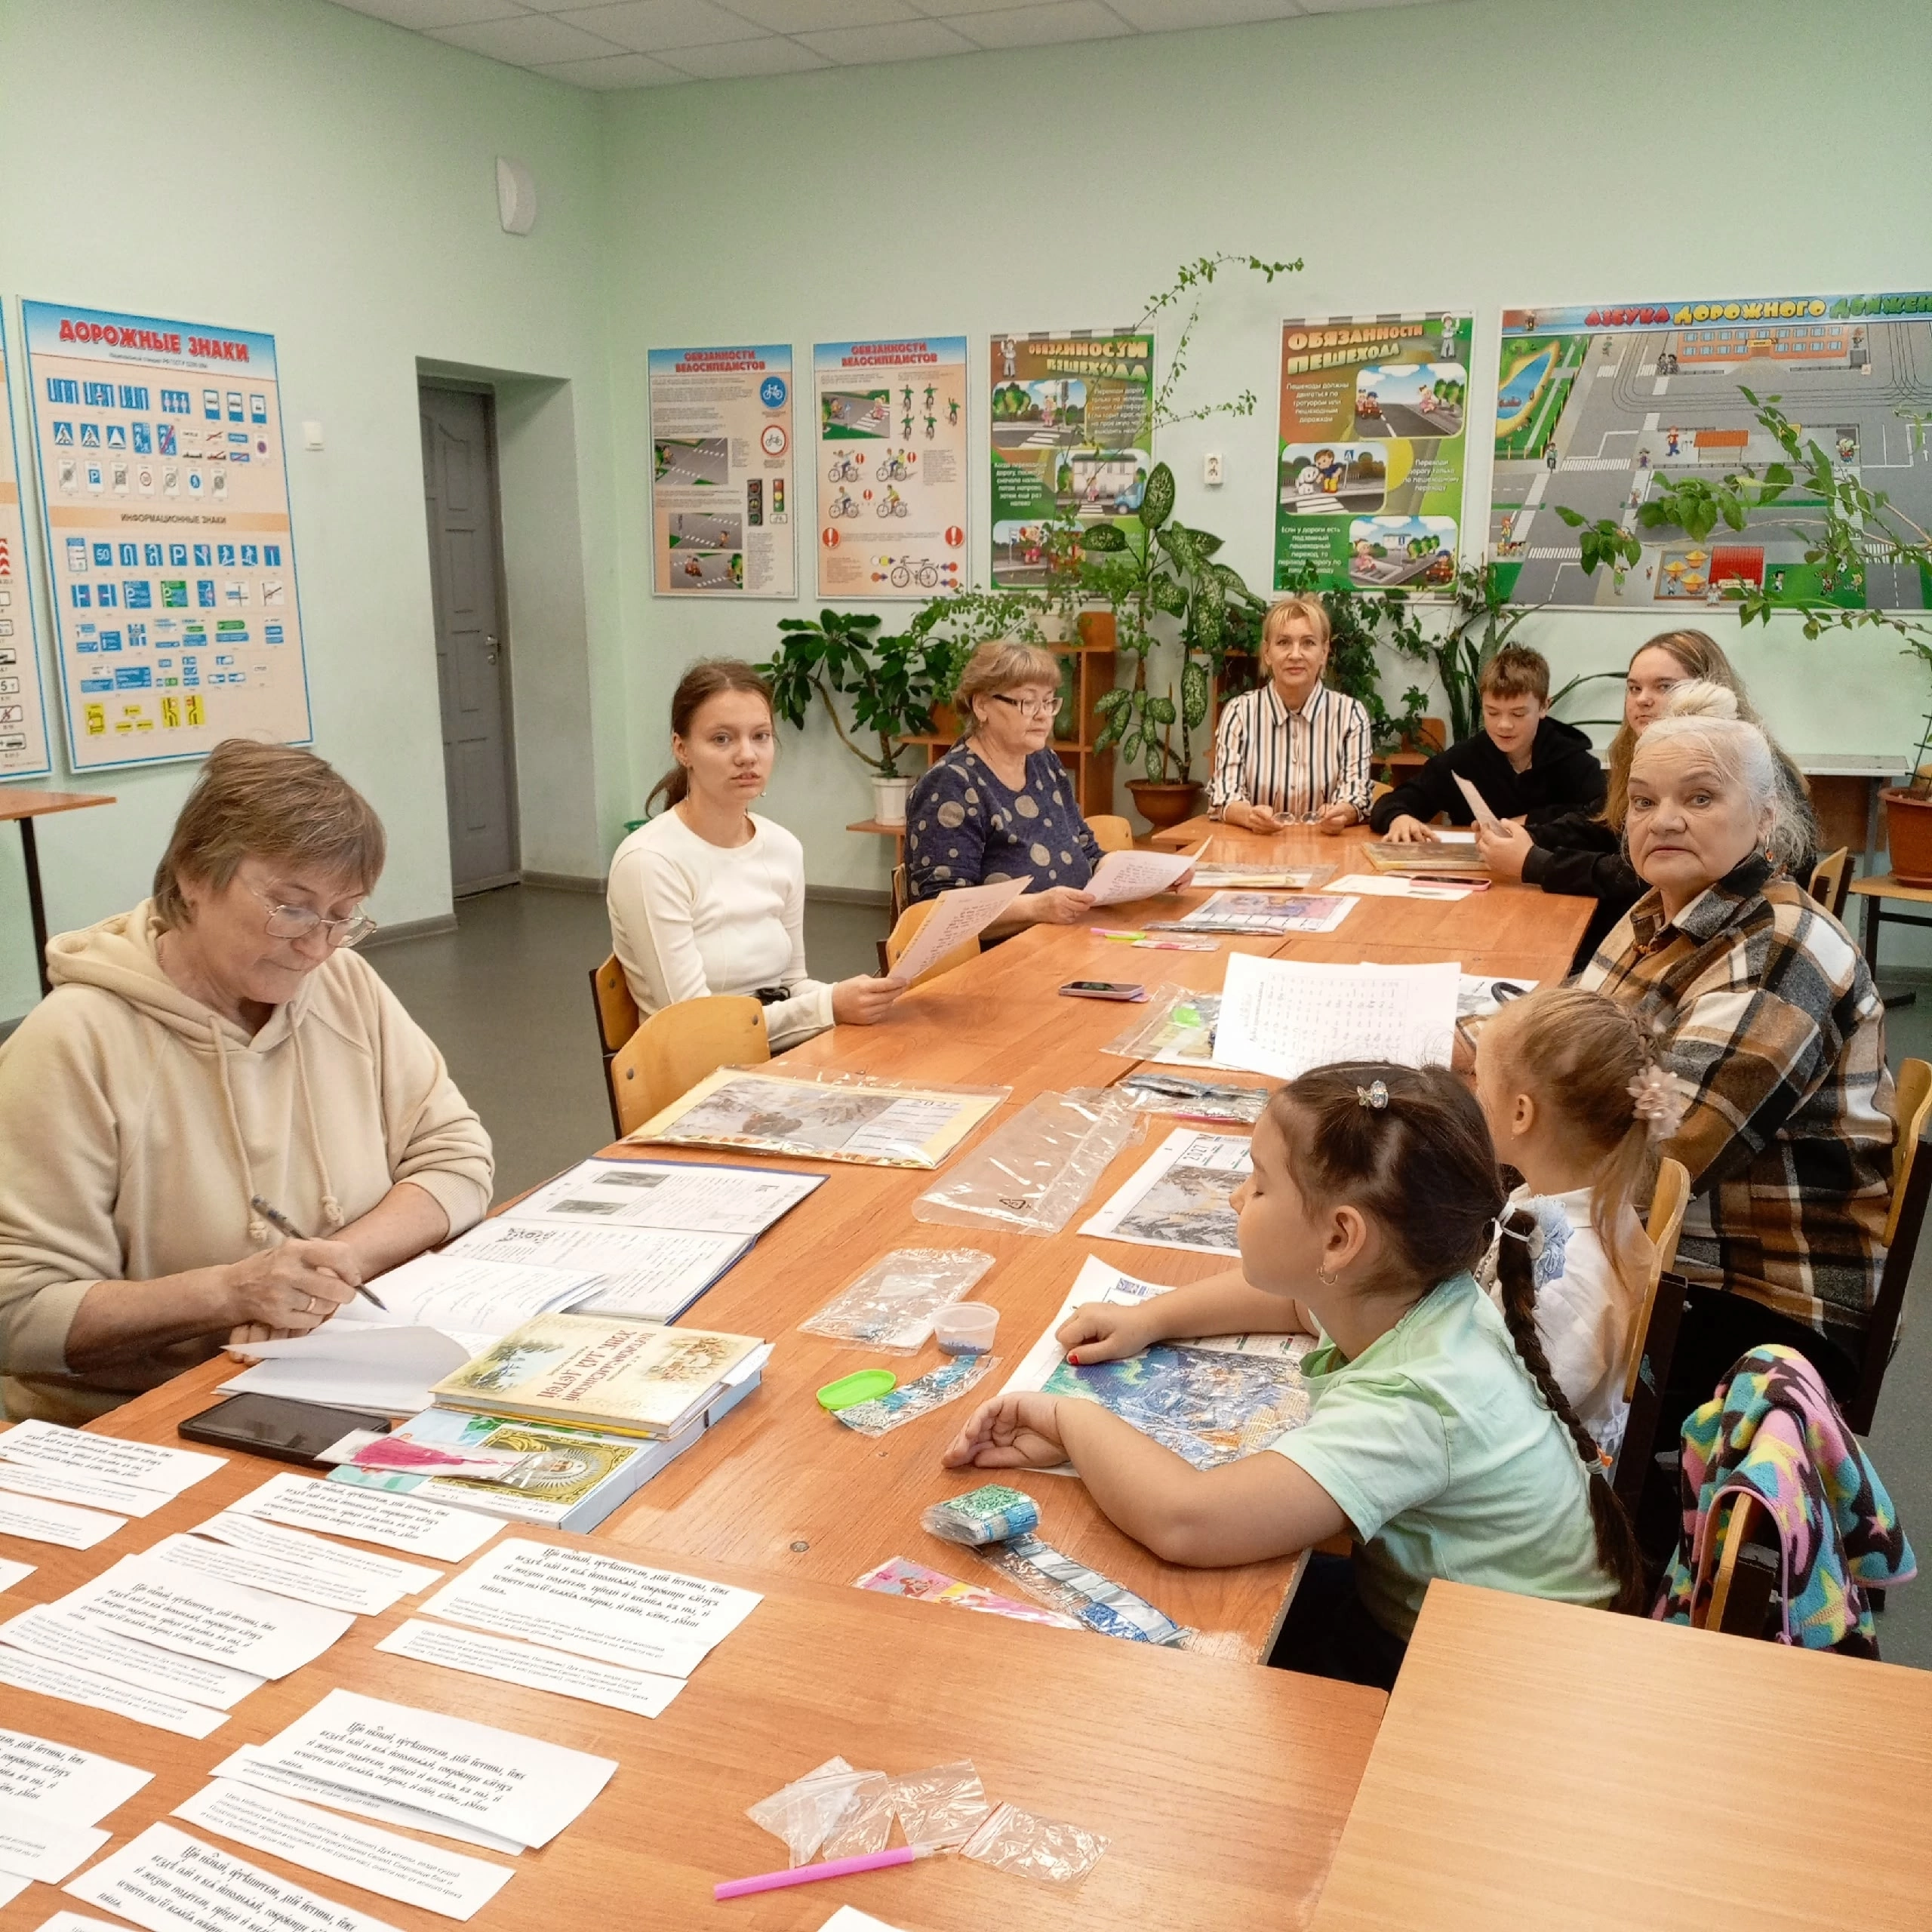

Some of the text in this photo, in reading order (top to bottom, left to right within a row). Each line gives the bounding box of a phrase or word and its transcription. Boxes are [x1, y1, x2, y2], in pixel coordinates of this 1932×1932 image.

[1585, 305, 1670, 326] АЗБУКА
[1673, 300, 1826, 325] ДОРОЖНОГО
[59, 318, 182, 354] ДОРОЖНЫЕ
[188, 336, 250, 362] ЗНАКИ
[1287, 325, 1424, 351] ОБЯЗАННОСТИ
[684, 350, 755, 361] ОБЯЗАННОСТИ
[851, 342, 927, 355] ОБЯЗАННОСТИ
[1029, 341, 1149, 358] ОБЯЗАННОСТИ
[675, 361, 766, 373] ВЕЛОСИПЕДИСТОВ
[841, 353, 937, 368] ВЕЛОСИПЕДИСТОВ
[1287, 343, 1400, 375] ПЕШЕХОДА
[1046, 358, 1149, 382] ПЕШЕХОДА
[97, 549, 110, 561] 50
